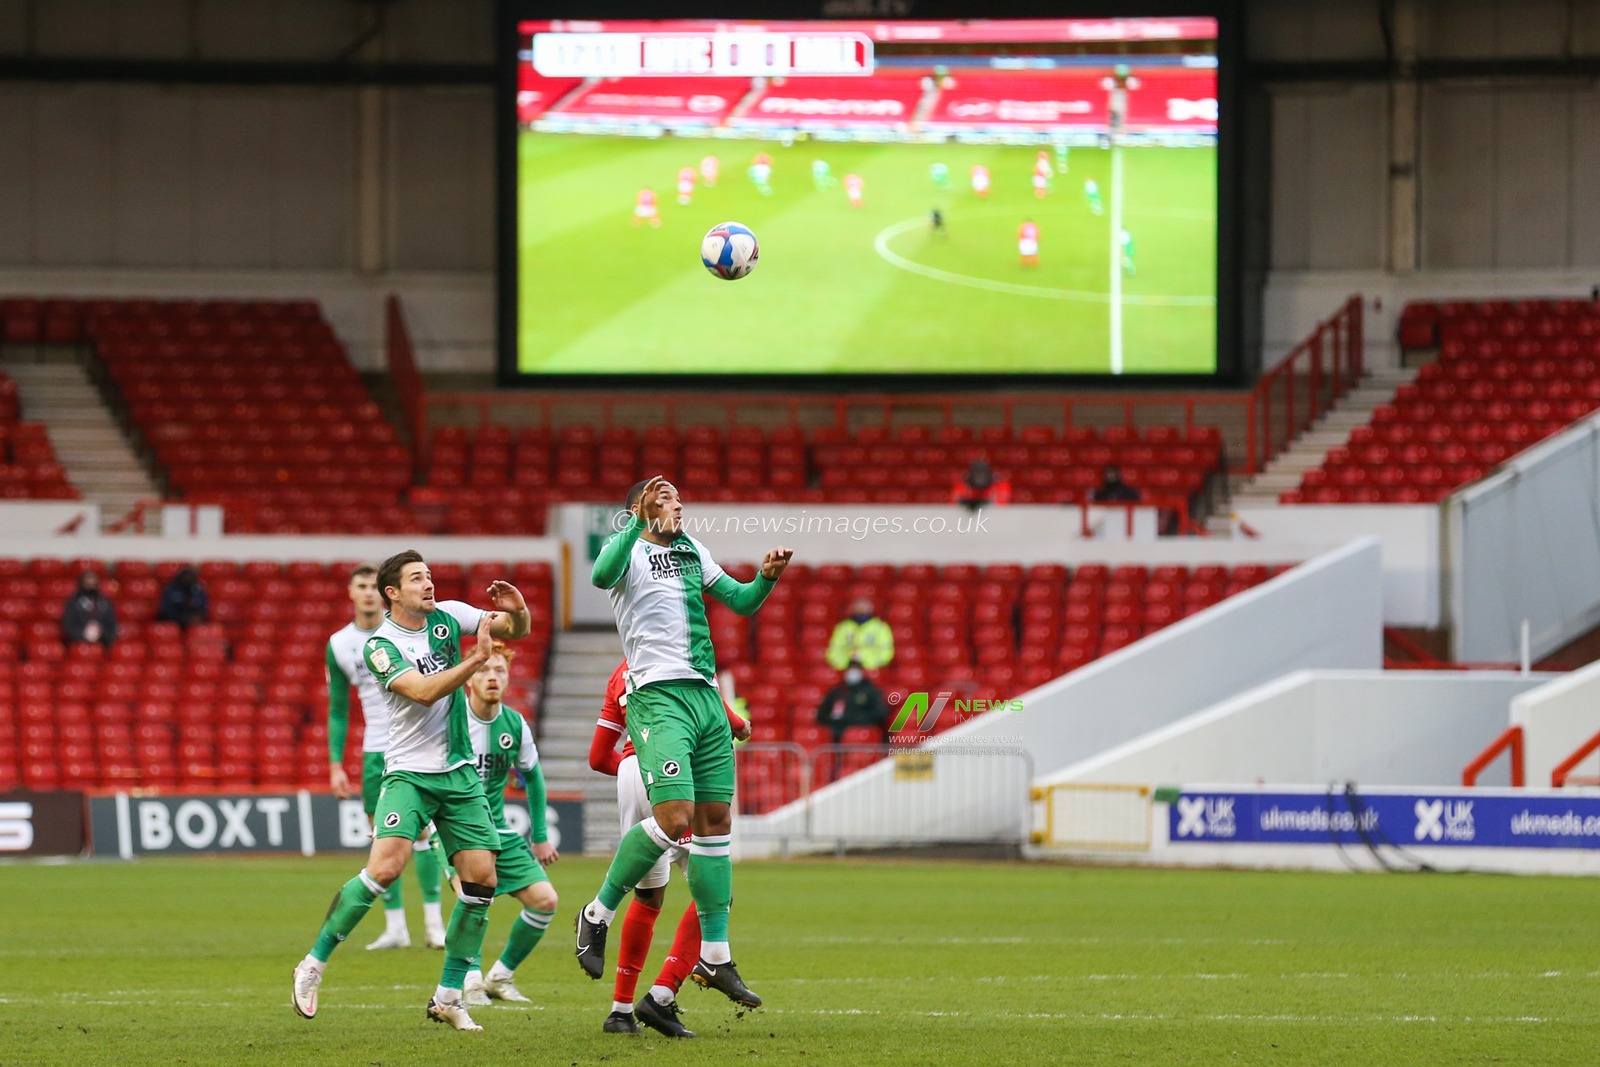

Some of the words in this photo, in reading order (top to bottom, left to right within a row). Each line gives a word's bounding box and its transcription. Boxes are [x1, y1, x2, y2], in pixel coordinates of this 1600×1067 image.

[651, 566, 700, 580] CHOCOLATE
[1206, 798, 1235, 818] UK
[1444, 801, 1474, 822] UK
[138, 799, 290, 850] BOXT
